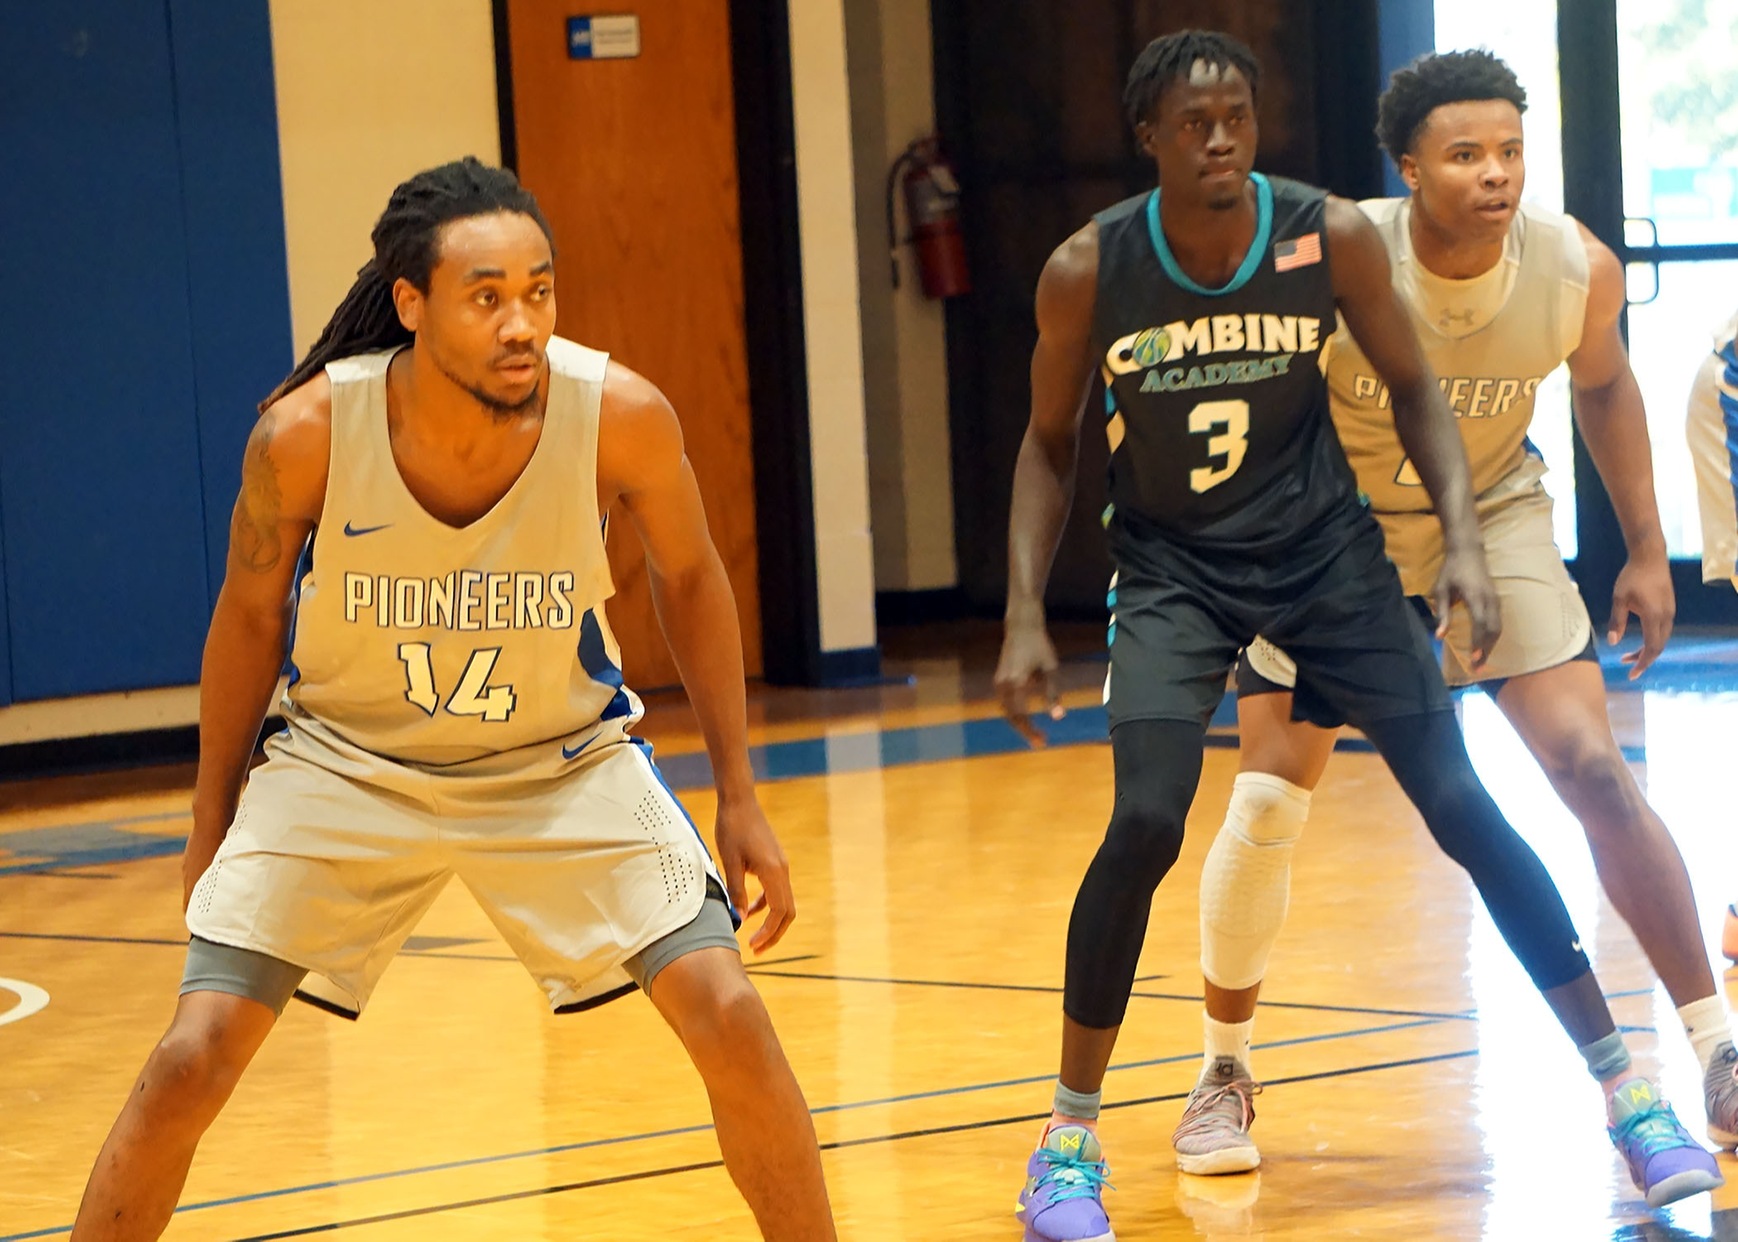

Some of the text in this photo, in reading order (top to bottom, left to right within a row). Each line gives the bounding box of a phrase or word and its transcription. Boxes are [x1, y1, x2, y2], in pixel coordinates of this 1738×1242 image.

[1139, 353, 1294, 393] ACADEMY
[1188, 399, 1250, 494] 3
[345, 570, 574, 630] PIONEERS
[398, 642, 517, 722] 14
